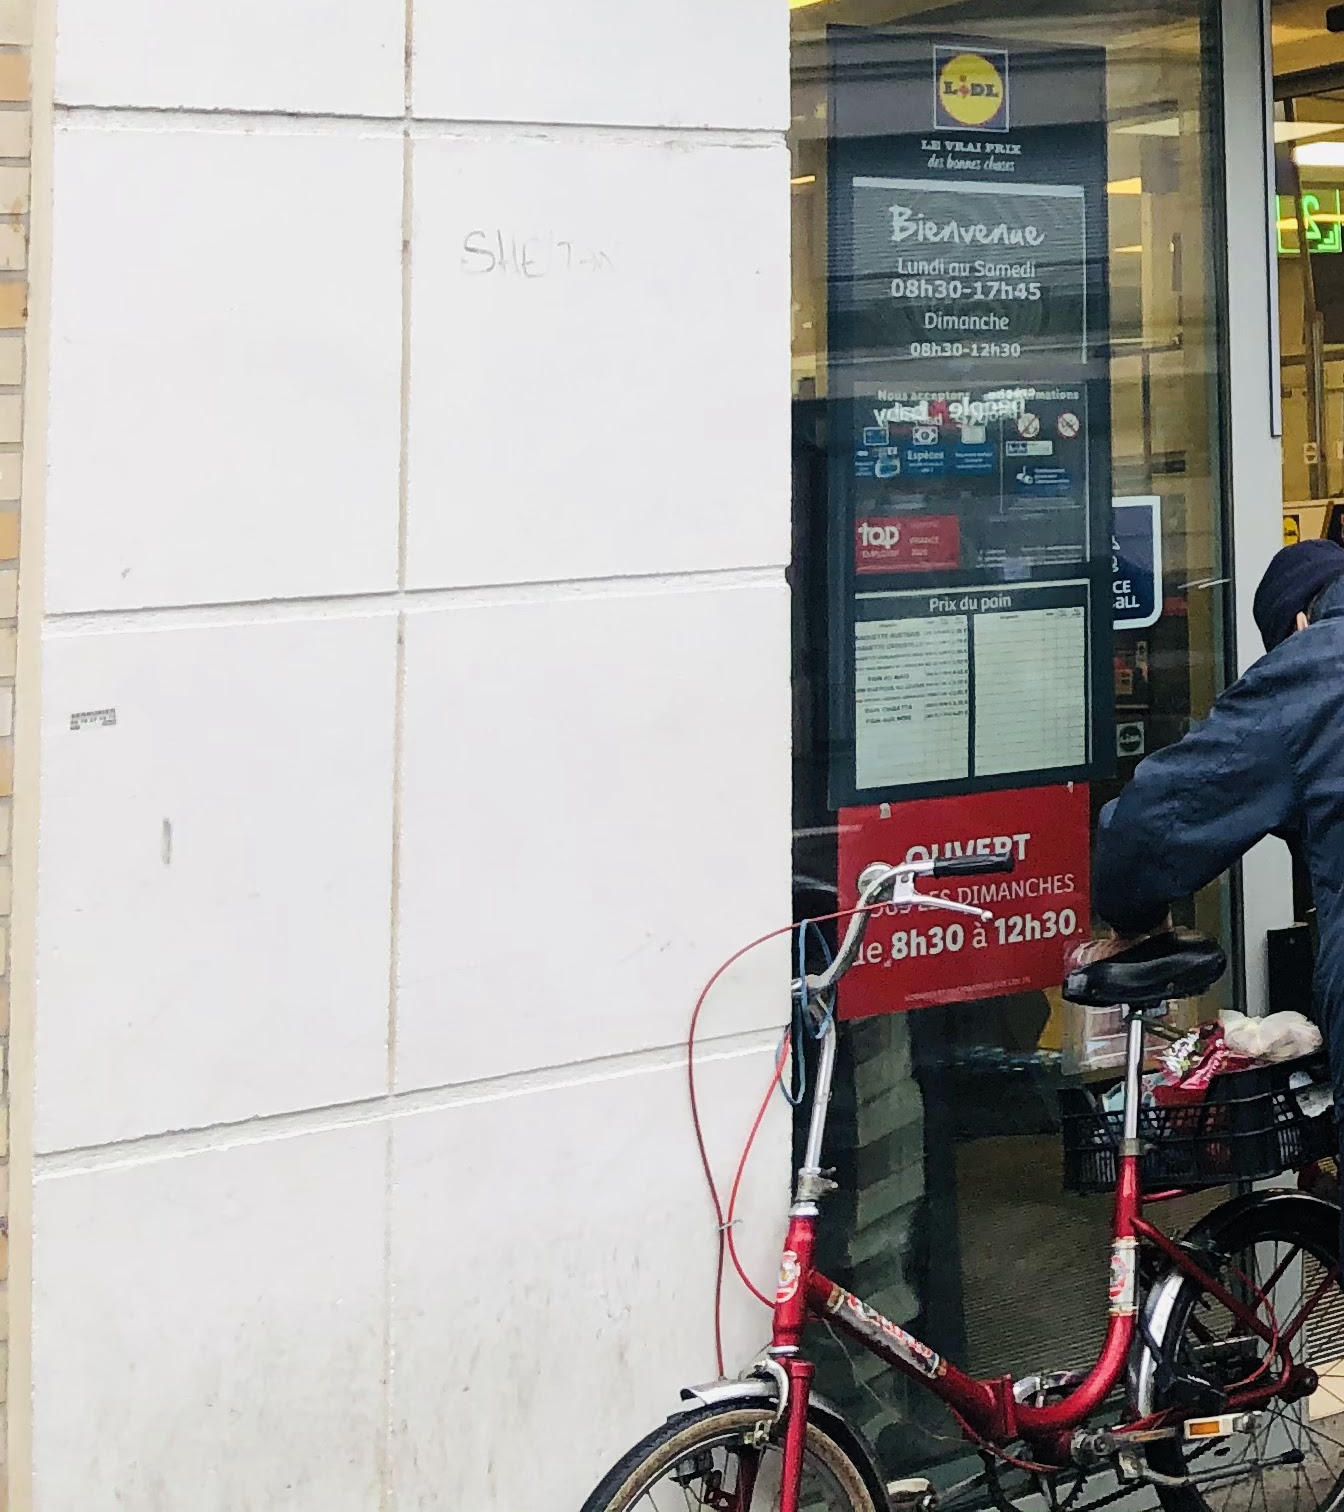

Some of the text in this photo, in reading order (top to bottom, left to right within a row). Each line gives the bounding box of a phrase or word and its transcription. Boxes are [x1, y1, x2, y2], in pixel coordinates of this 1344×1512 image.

[944, 140, 981, 153] VRAI
[985, 142, 1021, 155] PRIX
[889, 204, 1046, 246] Bienvenue
[898, 258, 1036, 278] Lundi au Samedi
[891, 278, 1042, 300] 08h30-17h45
[924, 312, 1010, 330] Dimanche
[910, 342, 1021, 358] 08h30-12h30
[857, 522, 900, 550] top
[929, 594, 1012, 612] Prix du pain
[957, 873, 1075, 908] DIMANCHES
[890, 923, 964, 960] 8h30
[972, 921, 988, 948] à
[993, 908, 1083, 945] 12h30.
